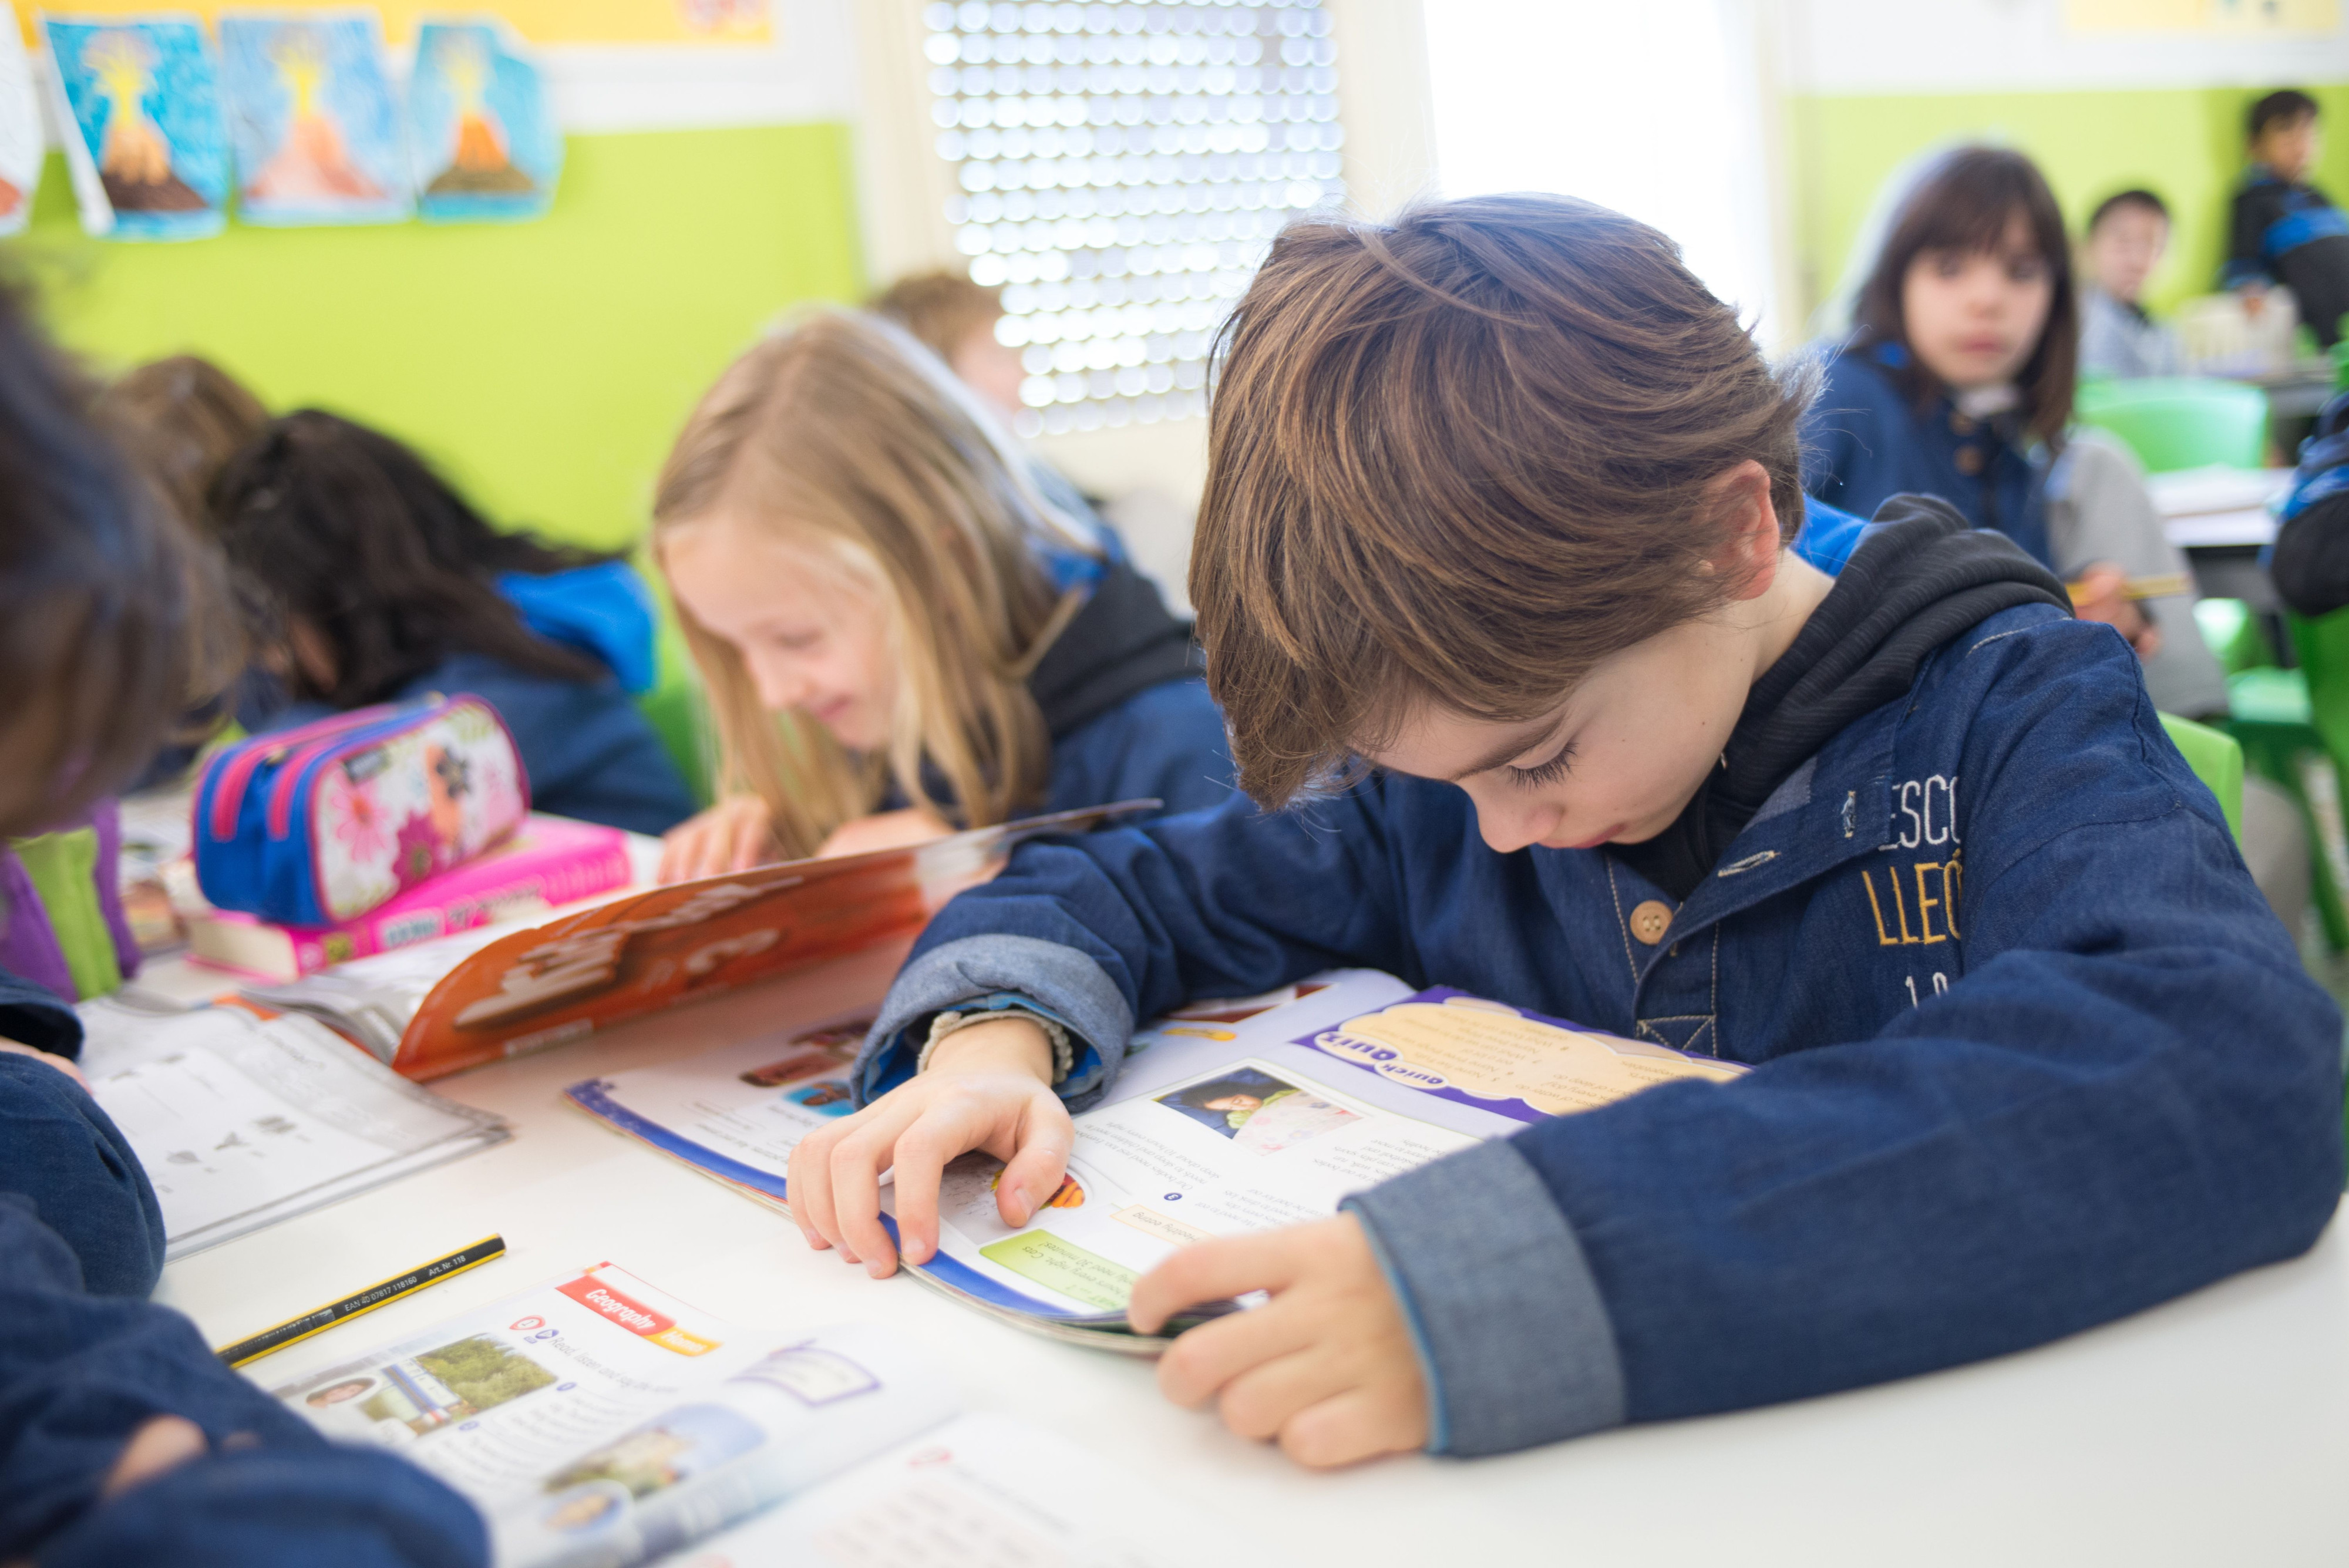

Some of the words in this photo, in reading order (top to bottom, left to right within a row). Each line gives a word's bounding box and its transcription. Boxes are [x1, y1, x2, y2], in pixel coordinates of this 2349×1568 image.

[1132, 1212, 1162, 1226] eating
[1162, 1223, 1200, 1242] Healthy
[1022, 1246, 1044, 1259] Cats
[1038, 1241, 1081, 1261] minutes!
[429, 1267, 443, 1277] Art.
[453, 1255, 466, 1266] 118
[1075, 1259, 1093, 1267] 30
[1089, 1264, 1116, 1277] need
[1070, 1267, 1097, 1281] every
[345, 1299, 361, 1312] EAN
[371, 1287, 392, 1301] 07817
[393, 1276, 418, 1291] 118160
[586, 1288, 657, 1330] Geography
[549, 1337, 579, 1357] Read,
[573, 1352, 601, 1370] listen
[598, 1367, 625, 1379] and
